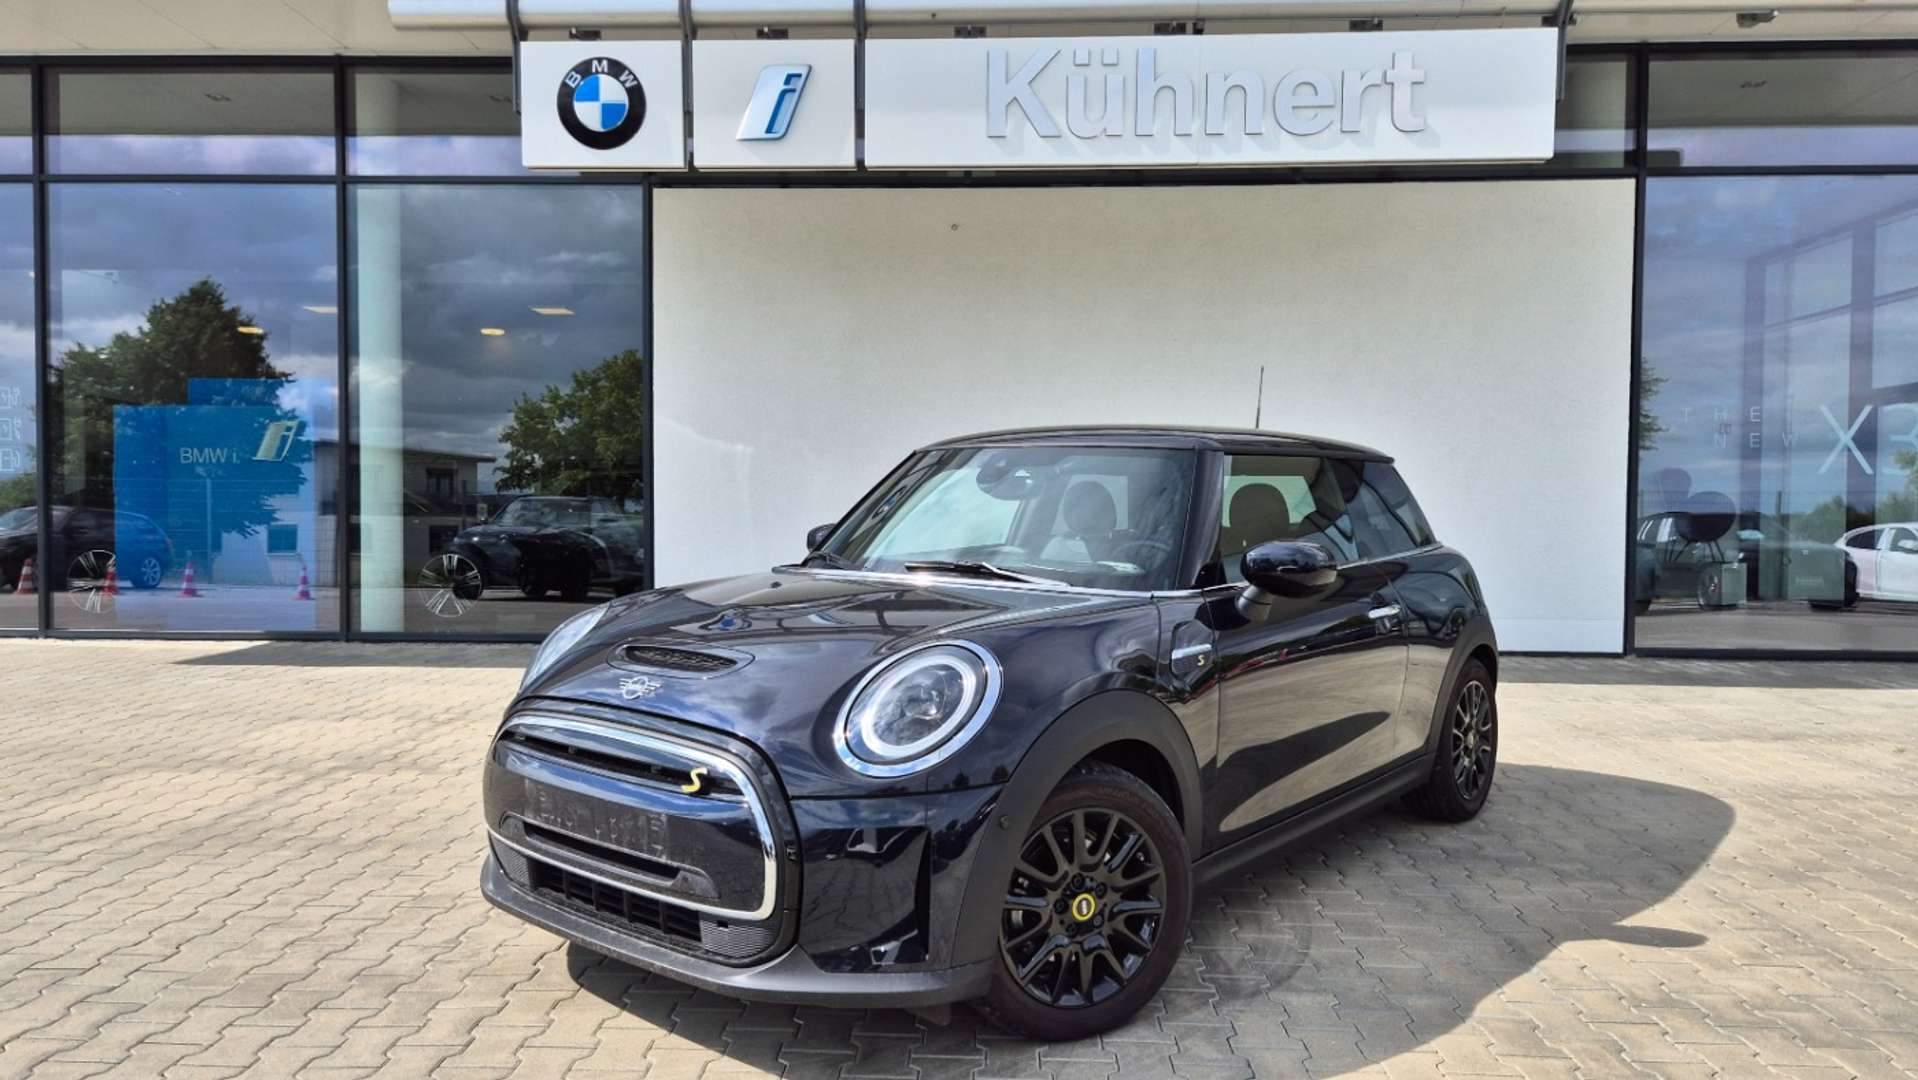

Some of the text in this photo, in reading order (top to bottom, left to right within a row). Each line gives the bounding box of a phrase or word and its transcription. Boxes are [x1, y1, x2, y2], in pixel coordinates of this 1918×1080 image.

[565, 59, 638, 88] BMW
[986, 46, 1426, 139] Kühnert
[1681, 406, 1761, 422] THE
[1714, 432, 1799, 448] NEW
[180, 447, 227, 464] BMW
[1197, 654, 1205, 666] S
[681, 767, 707, 793] S
